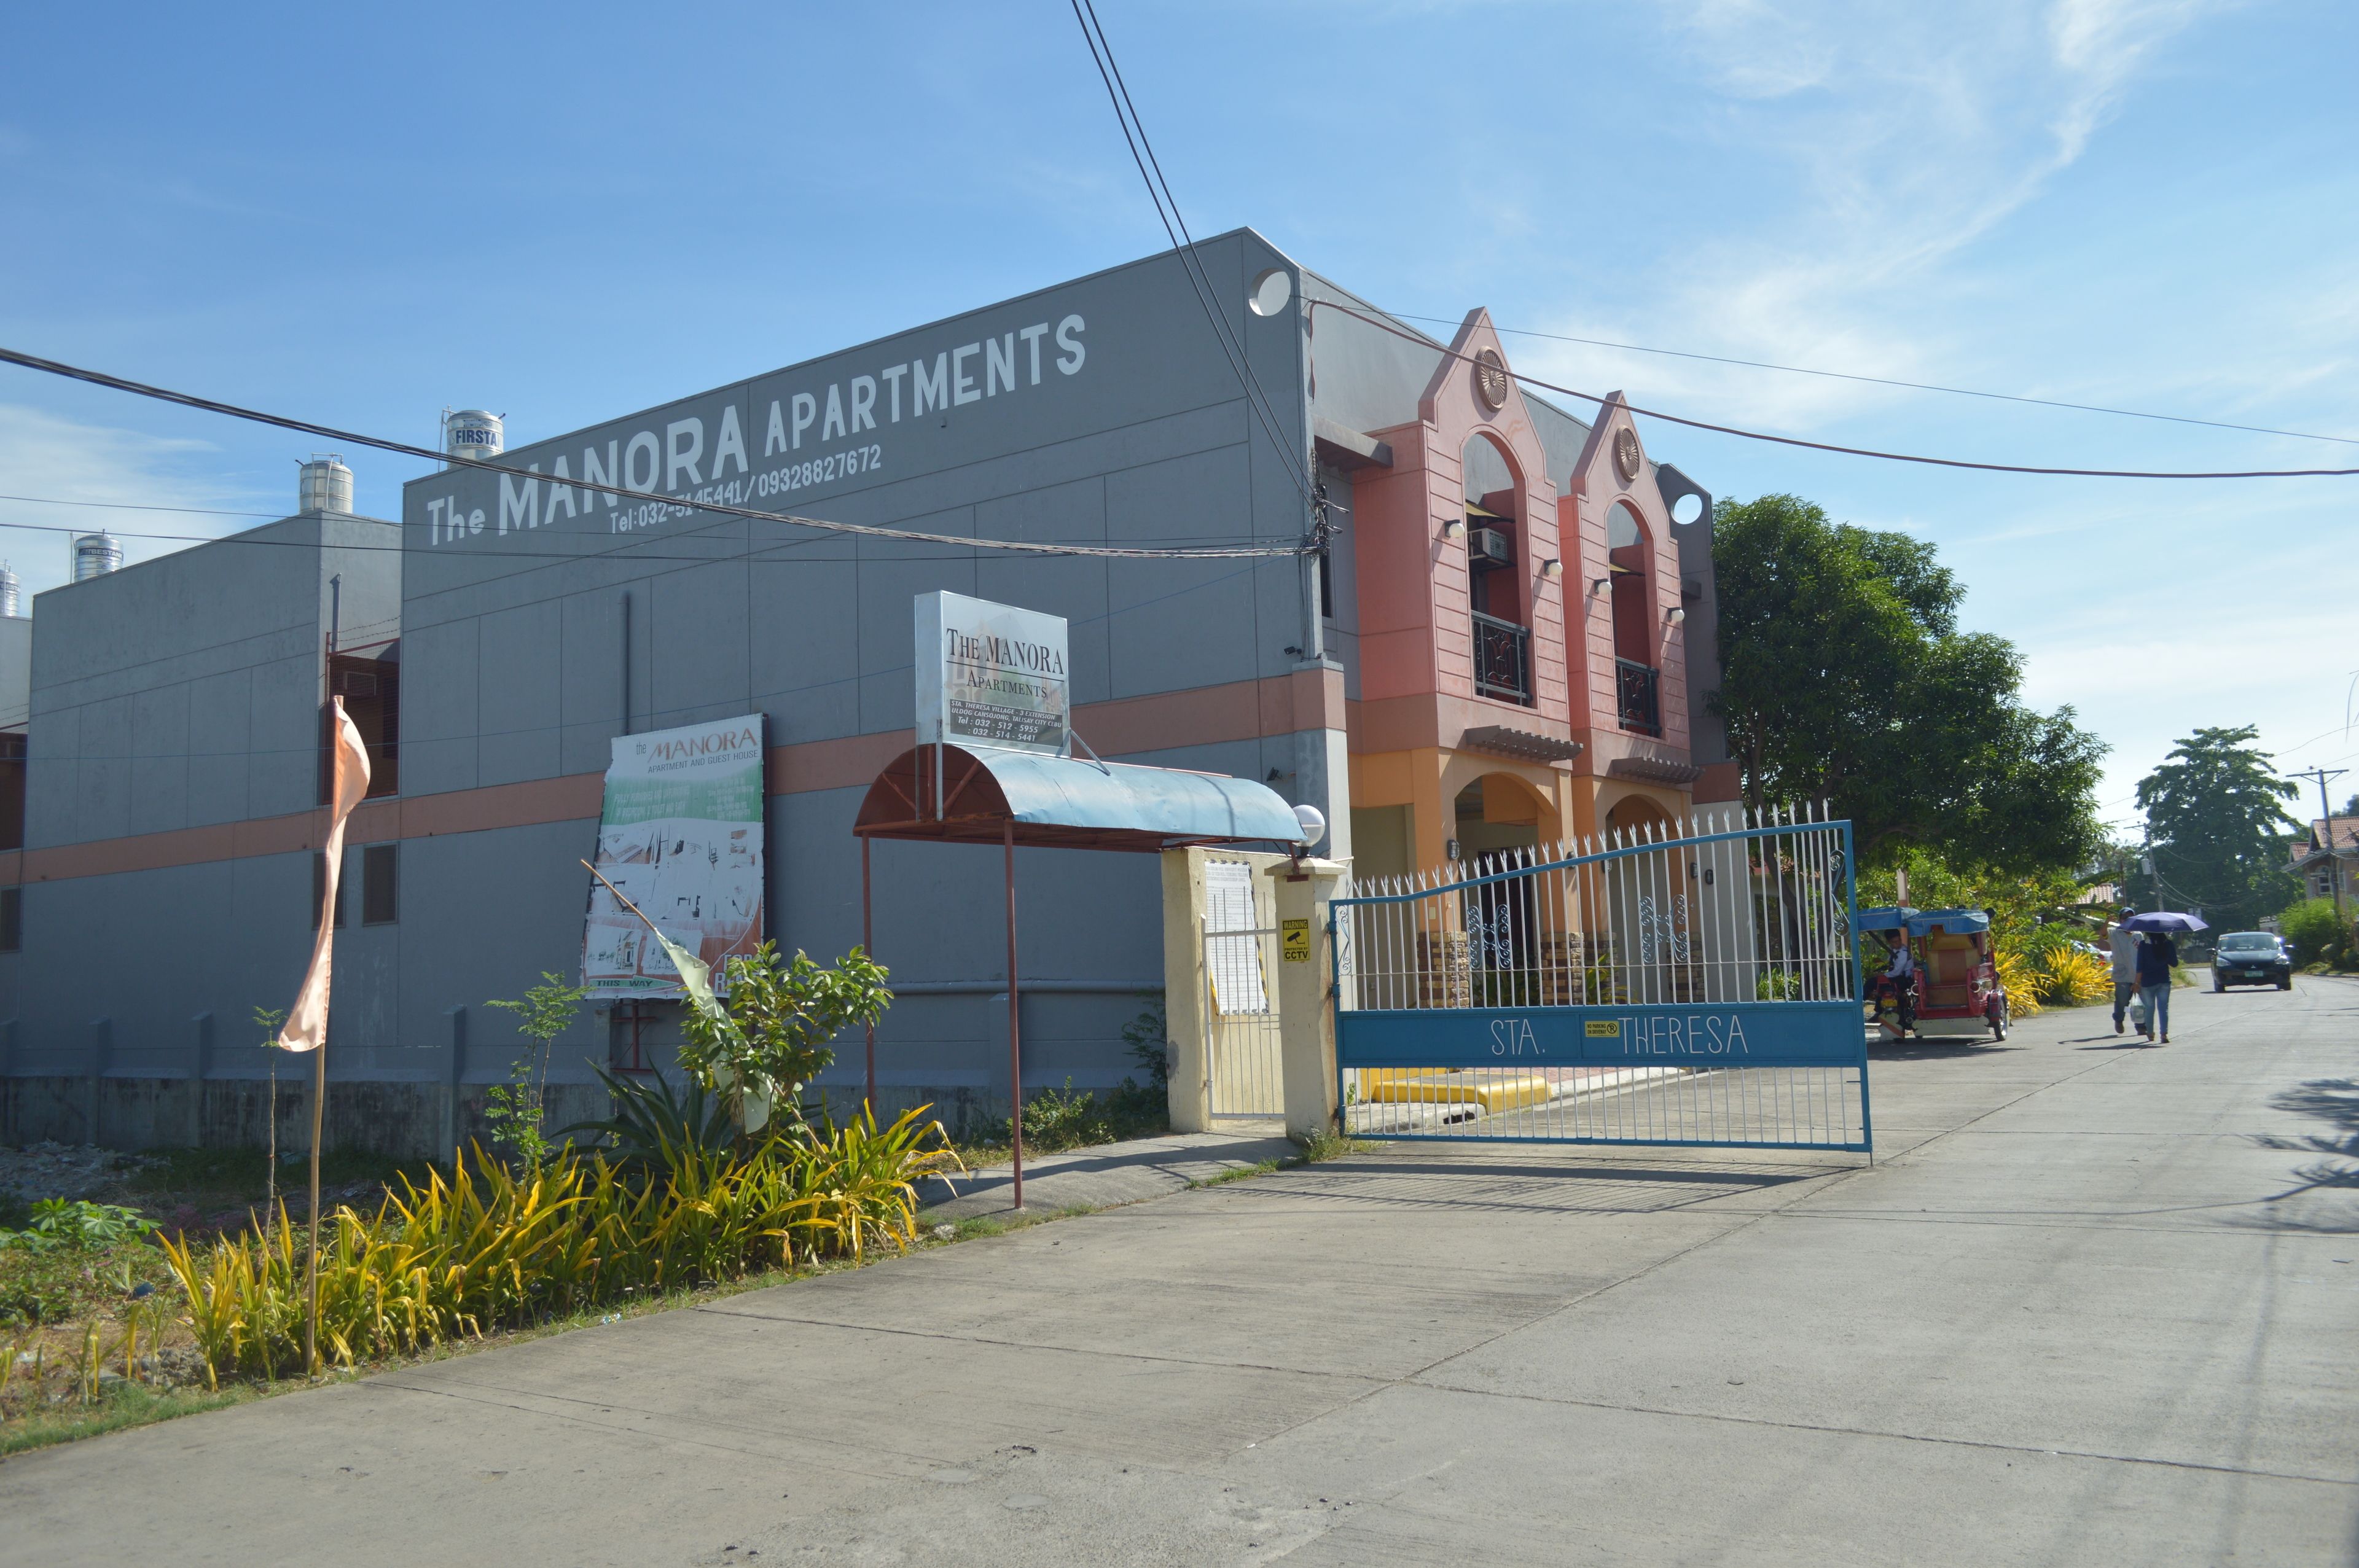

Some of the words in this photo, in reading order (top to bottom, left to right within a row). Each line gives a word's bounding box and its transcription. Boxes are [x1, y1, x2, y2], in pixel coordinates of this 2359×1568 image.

[427, 495, 487, 546] The
[498, 404, 749, 536] MANORA
[764, 314, 1086, 458] APARTMENTS
[456, 429, 498, 447] FIRSTA
[946, 628, 980, 660] THE
[986, 635, 1064, 675] MANORA
[966, 669, 1047, 698] APARTMENTS
[965, 702, 990, 711] THERESA
[992, 706, 1014, 715] VILLAGE
[1025, 711, 1055, 720] EXTENSION
[1017, 733, 1036, 742] 5441
[1019, 724, 1038, 733] 5955
[635, 741, 647, 755] the
[647, 727, 757, 764] MANORA
[647, 760, 687, 774] APARTMENT
[690, 757, 705, 767] AND
[708, 753, 731, 765] GUEST
[733, 749, 758, 760] HOUSE
[1283, 920, 1308, 929] WARNING
[1285, 951, 1309, 959] CCTV
[1490, 1018, 1546, 1056] STA.
[1616, 1015, 1749, 1055] THERESA
